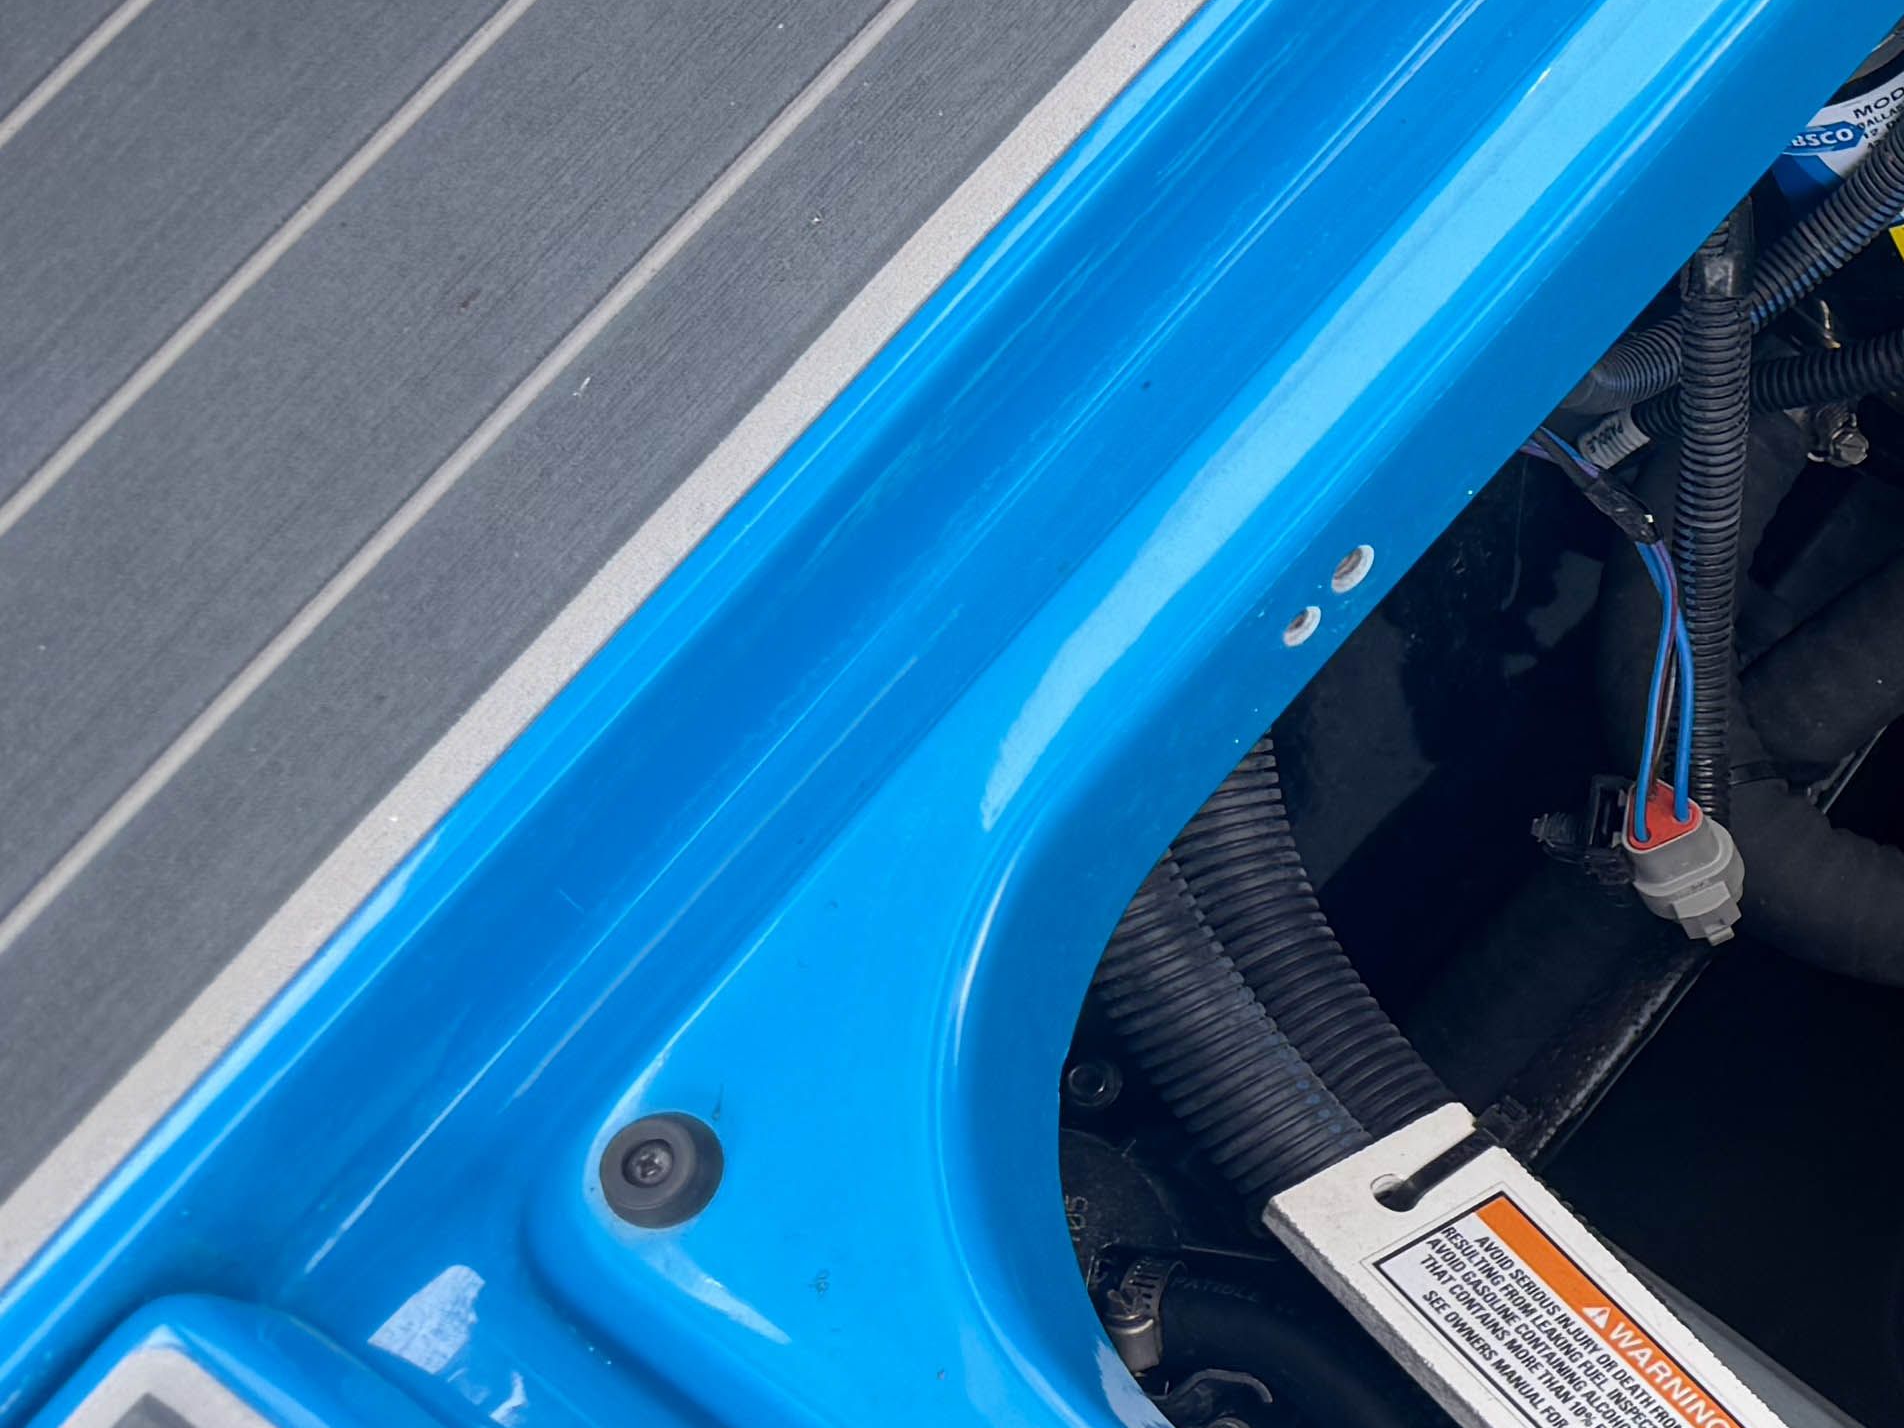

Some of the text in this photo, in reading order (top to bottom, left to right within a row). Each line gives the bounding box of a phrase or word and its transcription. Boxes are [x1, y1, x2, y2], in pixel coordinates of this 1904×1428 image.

[1420, 1254, 1456, 1285] THAT
[1449, 1284, 1511, 1341] CONTAINS
[1503, 1338, 1544, 1374] MORE
[1537, 1369, 1576, 1404] THAN
[1569, 1401, 1596, 1427] 10%
[1422, 1290, 1451, 1314] SEE
[1444, 1311, 1498, 1361] OWNERS
[1491, 1358, 1545, 1410] MANUAL
[1426, 1233, 1467, 1273] AVOID
[1461, 1271, 1521, 1326] GASOLINE
[1514, 1323, 1587, 1392] CONTAINING
[1441, 1223, 1505, 1286] RESULTING
[1499, 1283, 1538, 1318] FROM
[1530, 1314, 1583, 1363] LEAKING
[1474, 1236, 1514, 1270] AVOID
[1508, 1269, 1561, 1316] SERIOUS
[1554, 1313, 1602, 1354] INJURY
[1596, 1354, 1618, 1373] OR
[1611, 1369, 1656, 1409] DEATH
